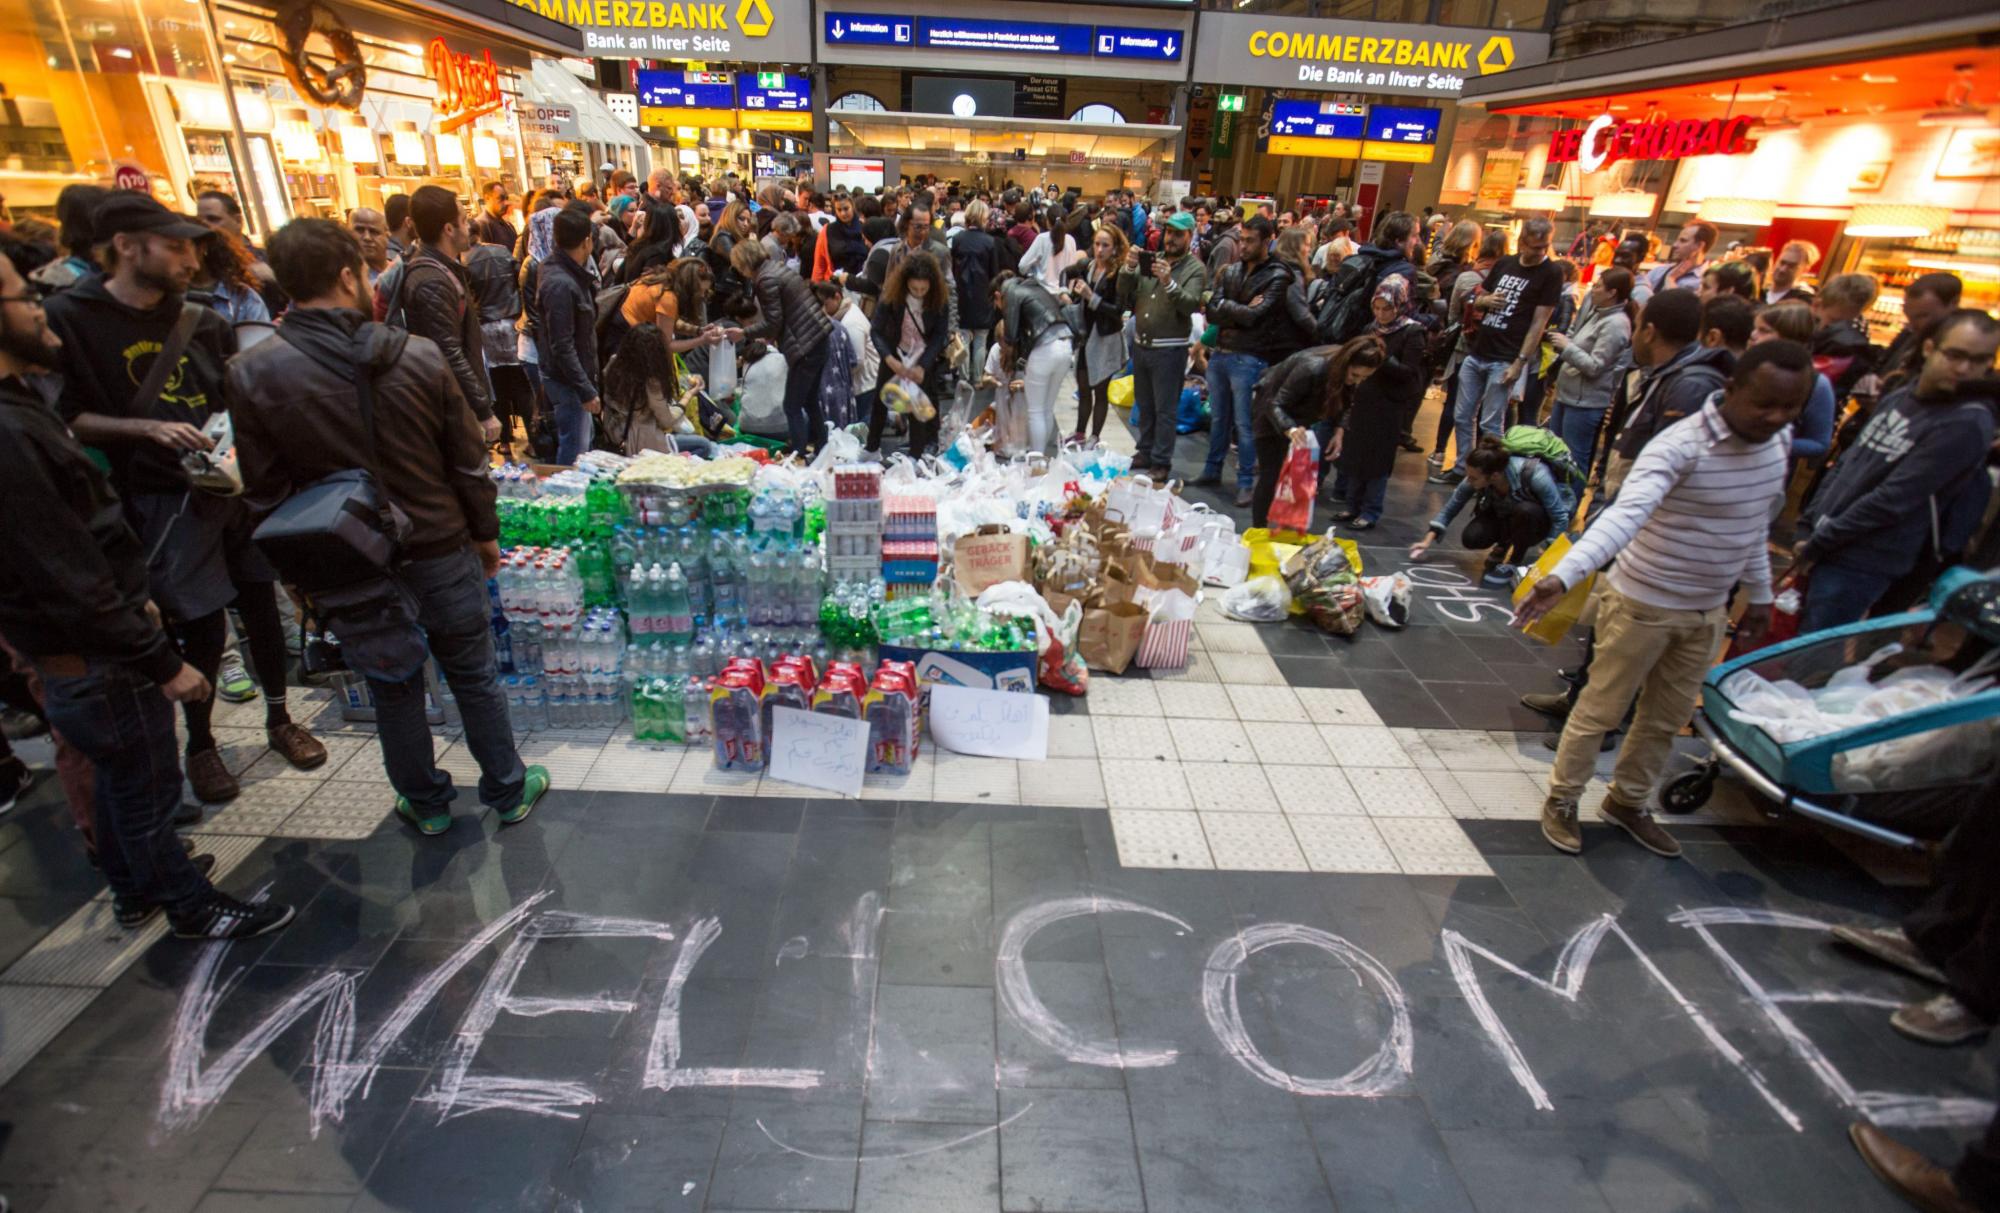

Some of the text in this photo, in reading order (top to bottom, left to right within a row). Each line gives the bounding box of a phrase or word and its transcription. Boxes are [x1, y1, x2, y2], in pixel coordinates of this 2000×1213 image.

[850, 22, 888, 33] Information
[587, 32, 731, 53] Bank an Ihrer Seite
[1120, 36, 1158, 48] Information
[1248, 30, 1472, 69] COMMERZBANK
[1299, 65, 1464, 90] Die Bank an Ihrer Seite
[1497, 273, 1530, 292] REFU
